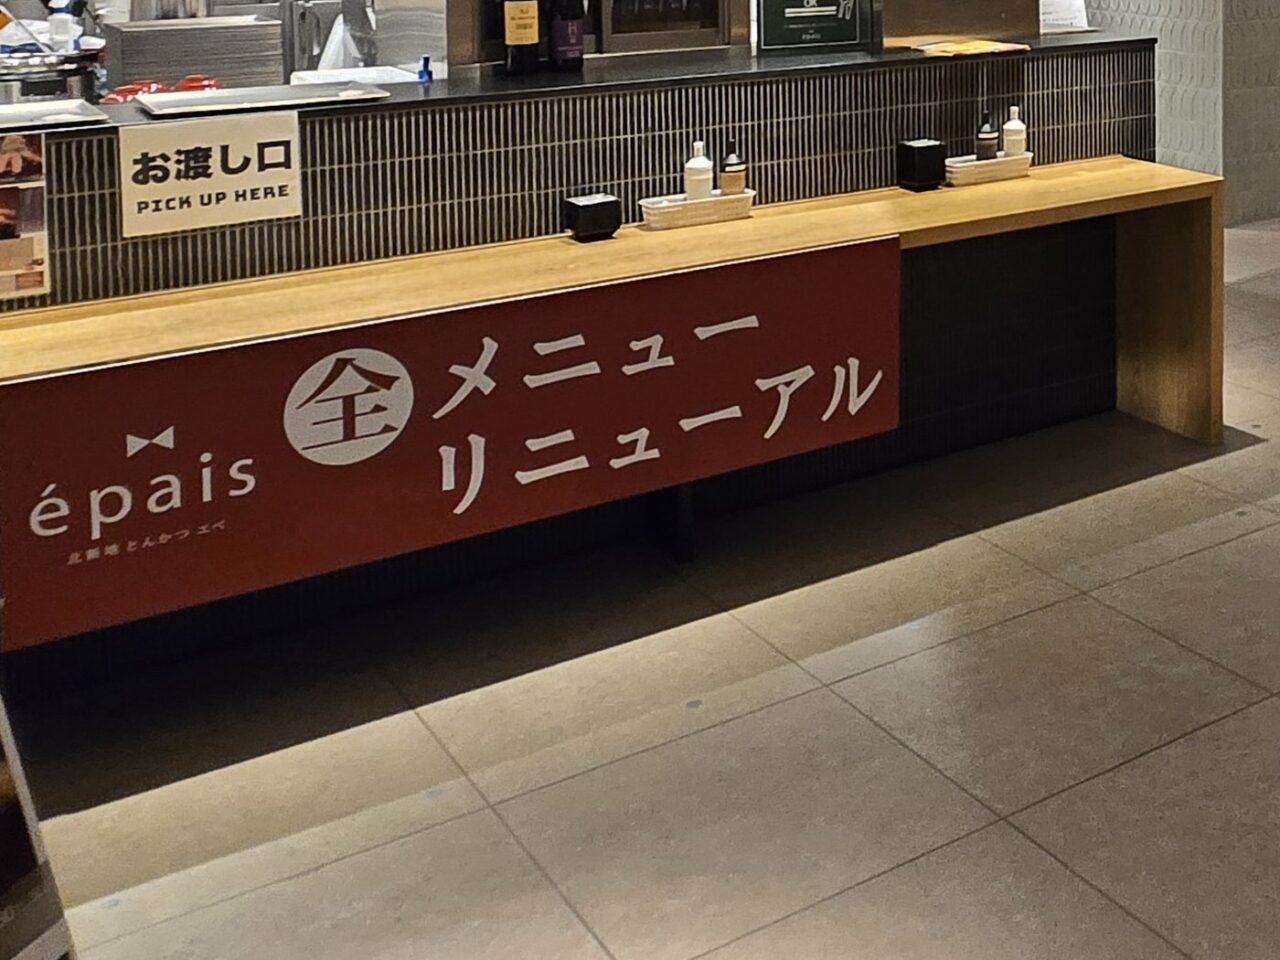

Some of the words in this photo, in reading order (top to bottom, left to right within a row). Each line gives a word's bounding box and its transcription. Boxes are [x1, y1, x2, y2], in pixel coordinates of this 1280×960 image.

[131, 140, 292, 185] お渡し口
[136, 195, 192, 214] PICK
[200, 191, 227, 207] UP
[234, 184, 289, 203] HERE
[432, 315, 759, 419] メニュー
[438, 356, 883, 515] リニューアル
[29, 452, 256, 540] épais
